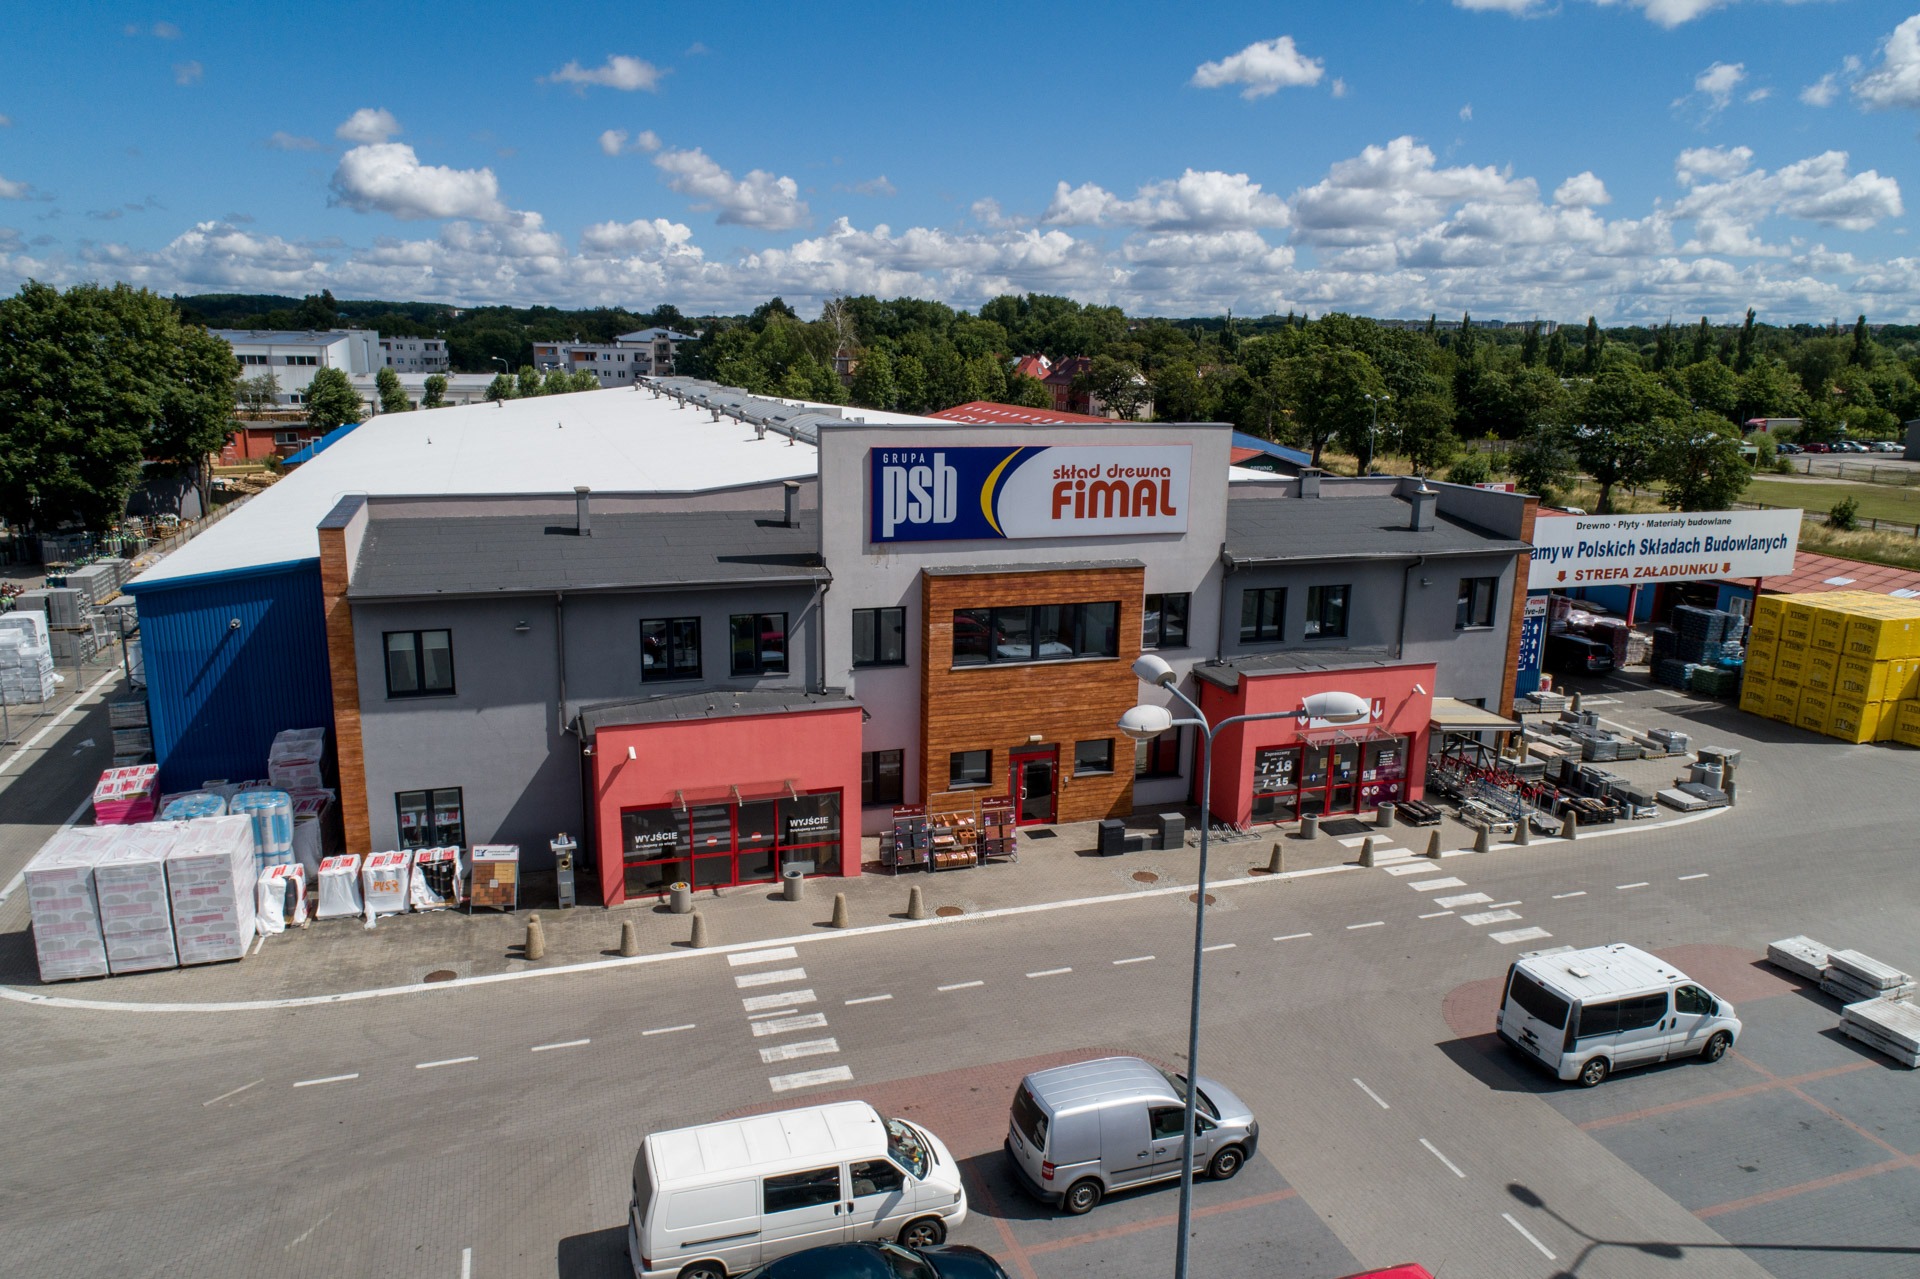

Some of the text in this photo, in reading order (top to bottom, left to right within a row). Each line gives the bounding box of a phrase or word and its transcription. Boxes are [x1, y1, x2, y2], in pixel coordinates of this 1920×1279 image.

[882, 453, 926, 464] GRUPA
[1053, 464, 1171, 480] skład drewna
[882, 452, 958, 538] psb
[1576, 517, 1732, 530] Drewno Płyty Materiały budowlane
[1562, 545, 1574, 558] w
[1577, 539, 1636, 558] Polskich
[1639, 536, 1700, 556] Składach
[1704, 533, 1788, 554] Budowlanych
[1574, 562, 1718, 581] STREFA ZAŁADUNKU
[1791, 610, 1809, 621] YTONG
[1851, 642, 1872, 654] YTONG
[790, 816, 829, 827] WYJŚCIE
[634, 832, 678, 843] WYJŚCIE
